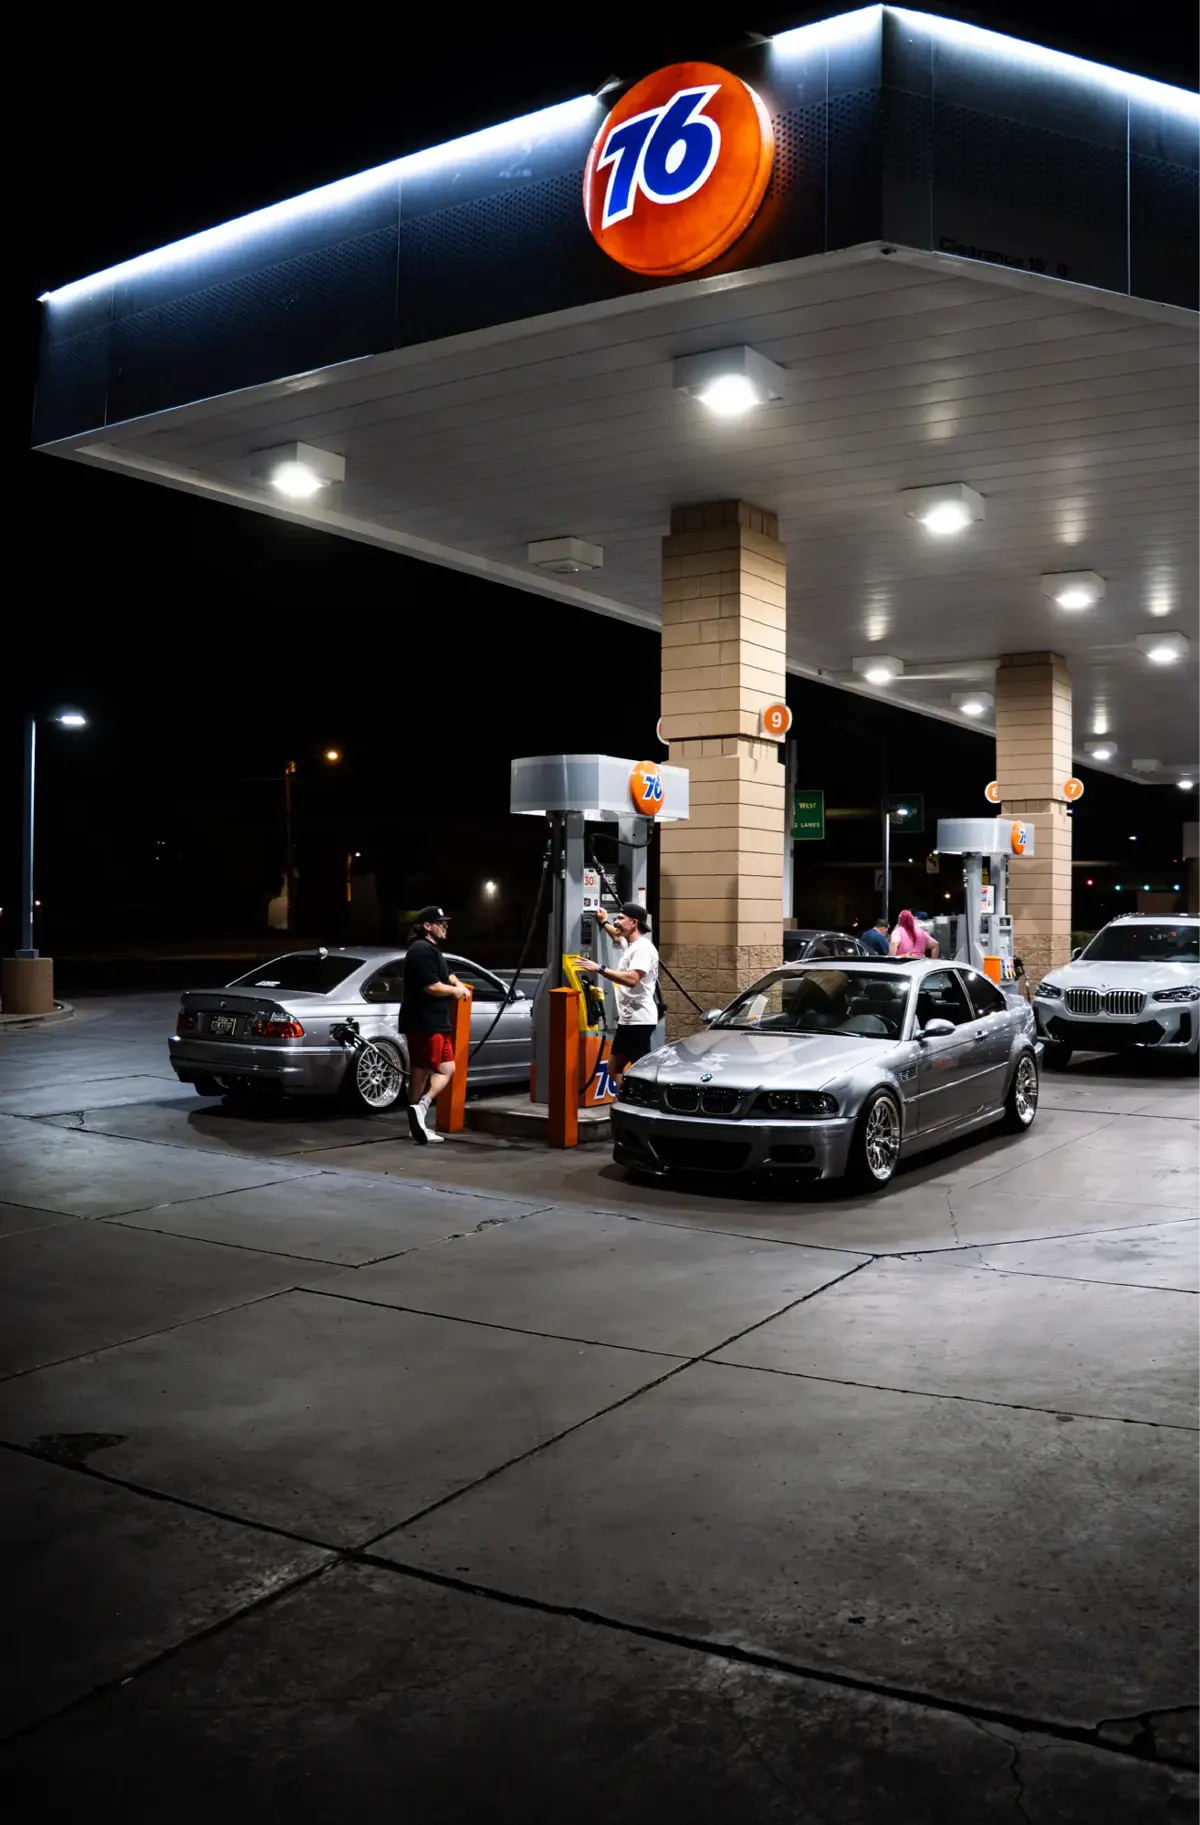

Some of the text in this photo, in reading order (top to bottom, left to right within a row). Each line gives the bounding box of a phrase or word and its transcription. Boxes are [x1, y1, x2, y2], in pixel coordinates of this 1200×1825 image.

[596, 84, 722, 230] 76
[771, 712, 782, 728] 9
[642, 774, 664, 801] 76
[1069, 783, 1078, 795] 7
